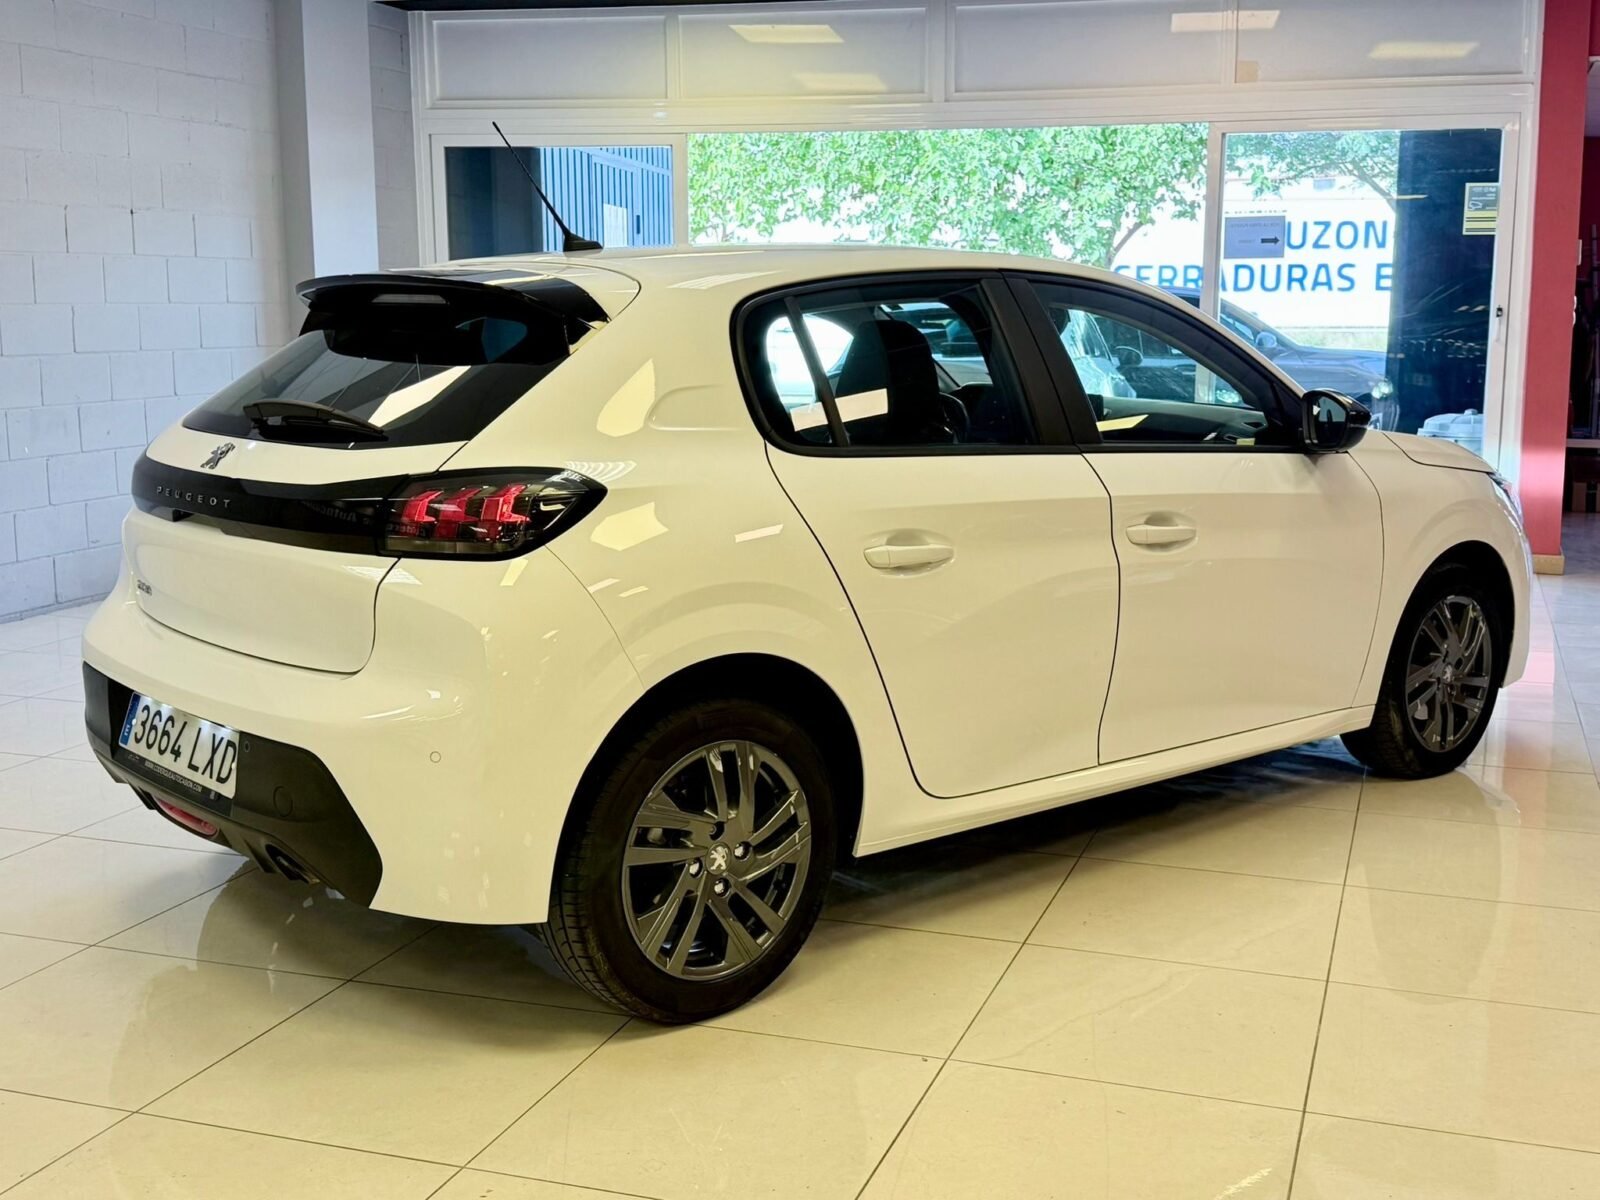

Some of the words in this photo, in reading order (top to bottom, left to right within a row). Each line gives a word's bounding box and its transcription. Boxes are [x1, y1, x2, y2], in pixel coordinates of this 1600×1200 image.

[1114, 263, 1356, 292] ERRDURAS
[156, 486, 231, 509] PEUGEOT
[134, 704, 188, 763] 3664
[187, 727, 237, 784] LXD
